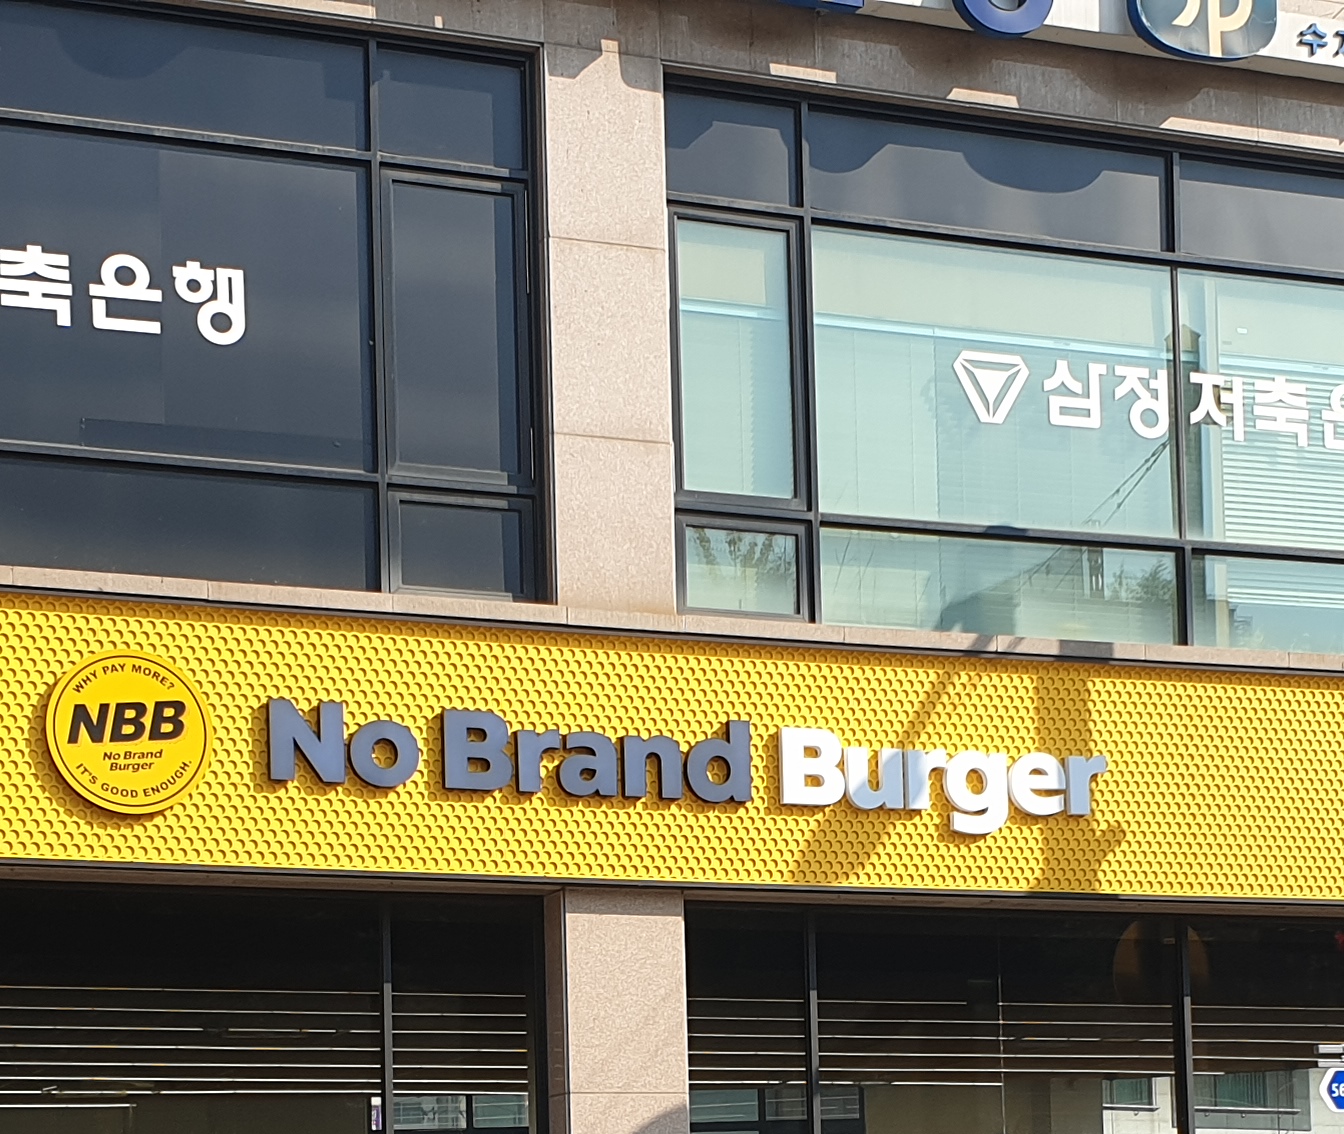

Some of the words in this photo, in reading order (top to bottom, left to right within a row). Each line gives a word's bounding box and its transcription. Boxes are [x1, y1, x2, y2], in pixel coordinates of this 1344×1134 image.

[1043, 358, 1171, 440] 삼정
[72, 669, 99, 694] WHY
[102, 663, 127, 675] PAY
[131, 664, 175, 691] MORE?
[67, 700, 187, 744] NBB
[102, 751, 121, 761] No
[123, 749, 163, 761] Brand
[109, 761, 155, 772] Burger
[266, 697, 421, 788] No
[442, 709, 752, 803] Brand
[778, 725, 1107, 836] Burger
[75, 763, 99, 785] IT'S
[100, 782, 139, 798] GOOD
[142, 760, 193, 797] ENOUGH.
